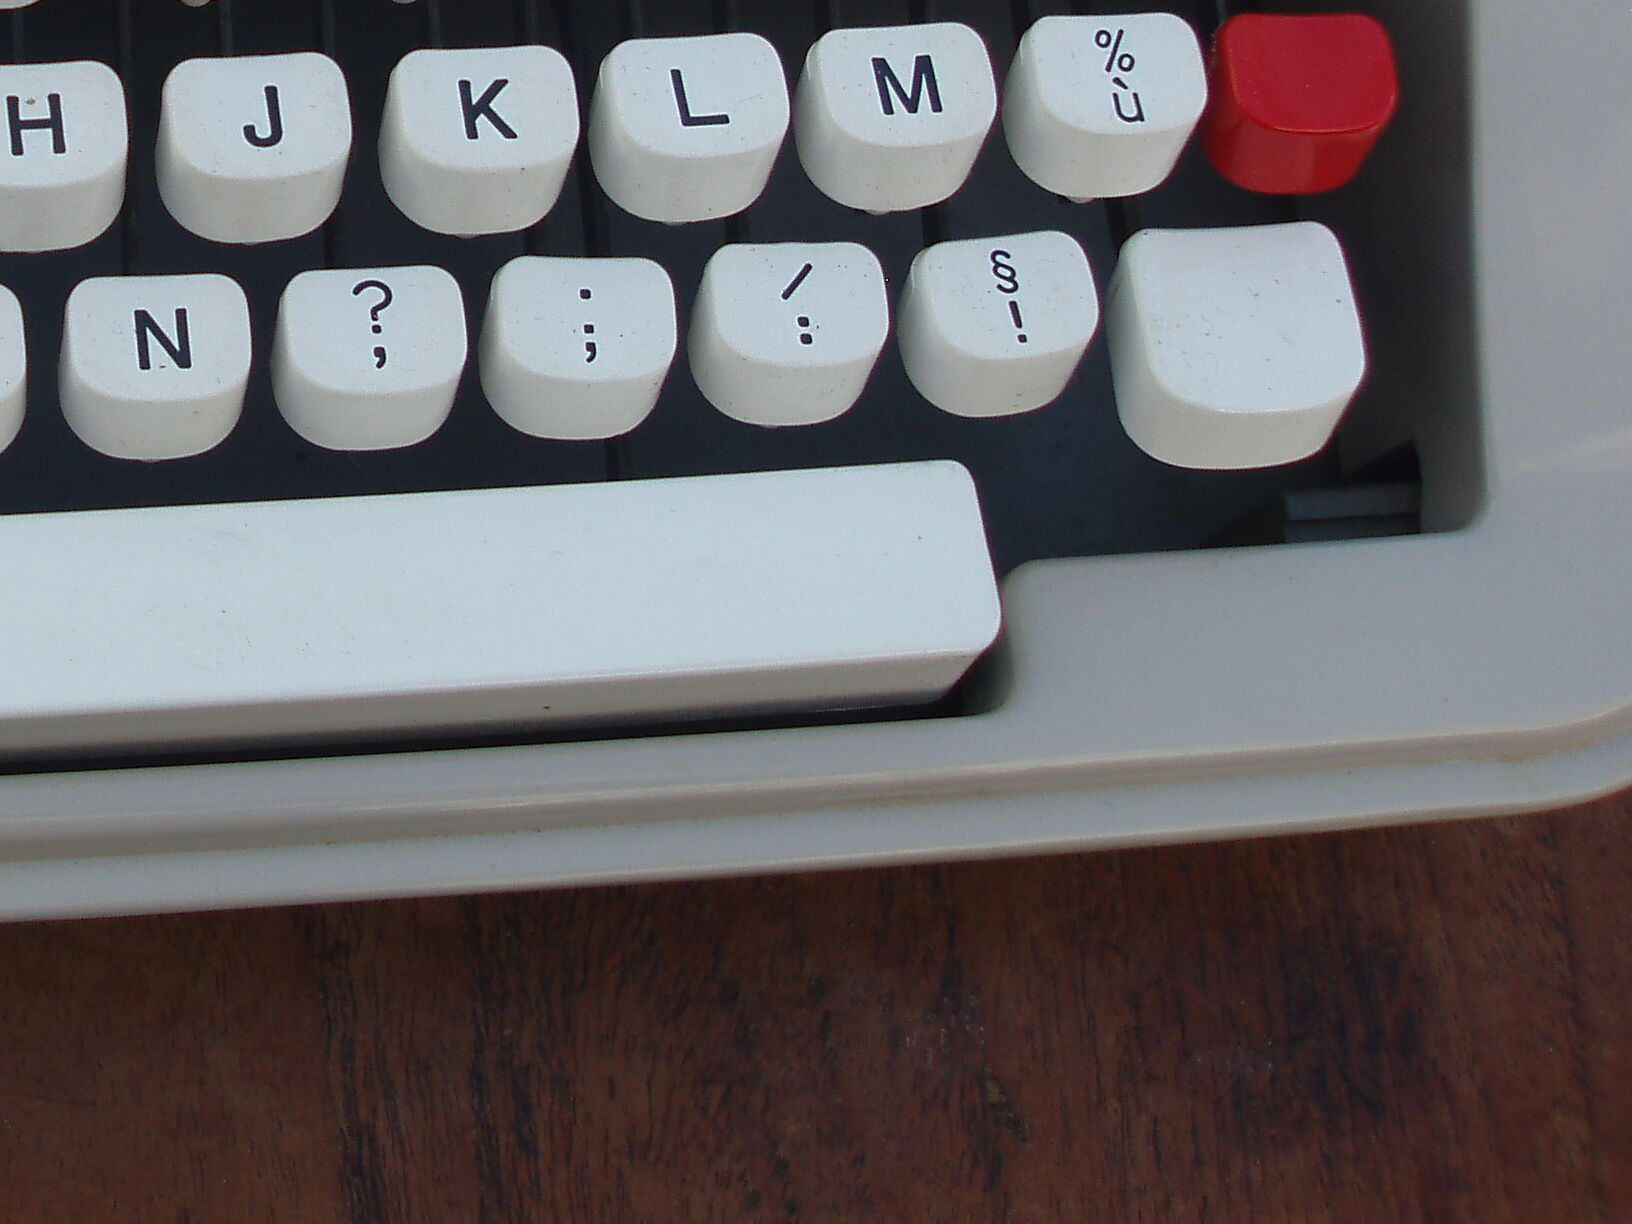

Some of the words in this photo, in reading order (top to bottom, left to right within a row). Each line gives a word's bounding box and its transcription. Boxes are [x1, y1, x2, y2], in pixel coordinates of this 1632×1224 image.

[1094, 29, 1135, 73] %
[458, 78, 518, 140] K
[670, 69, 730, 127] L
[871, 54, 943, 116] M
[1112, 76, 1145, 123] ù
[6, 93, 67, 157] H
[243, 85, 283, 148] J
[781, 263, 813, 300] /
[990, 249, 1019, 294] §
[352, 279, 393, 334] ?
[797, 316, 813, 345] :
[1008, 300, 1028, 344] !
[134, 307, 192, 371] N
